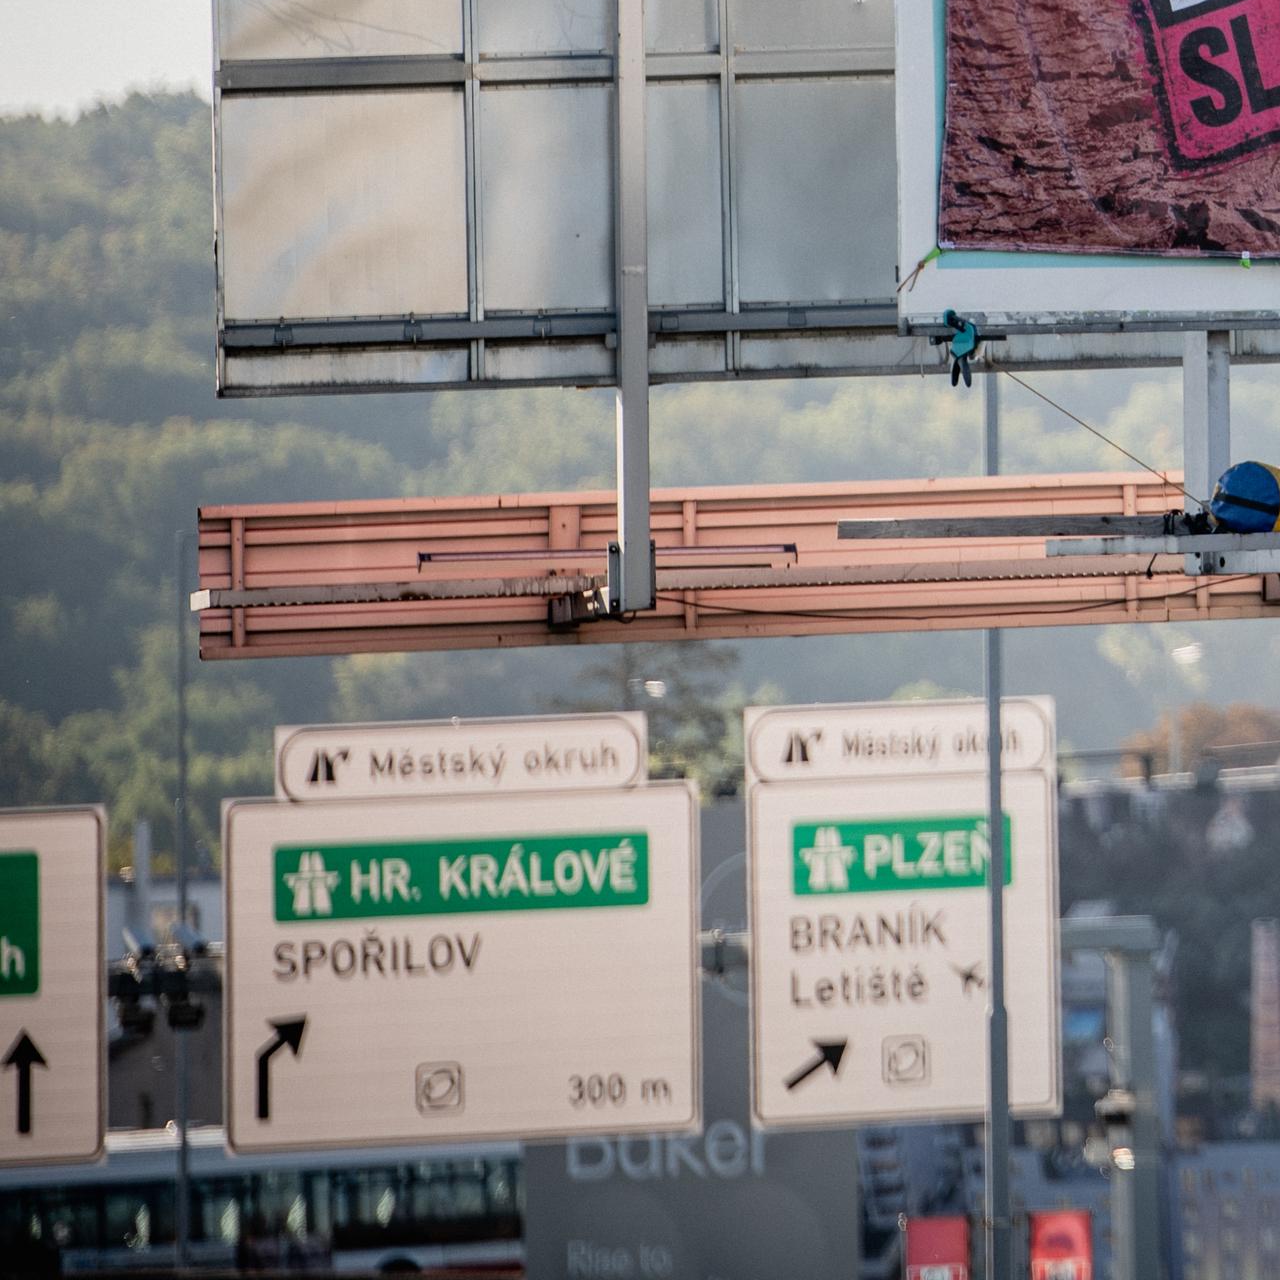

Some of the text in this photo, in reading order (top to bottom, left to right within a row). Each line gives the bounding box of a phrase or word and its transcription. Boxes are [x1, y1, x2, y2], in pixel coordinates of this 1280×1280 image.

[369, 740, 618, 783] Městský okruh
[350, 838, 638, 904] HR. KRÁLOVÉ
[790, 901, 946, 953] BRANÍK
[273, 928, 481, 982] SPOŘILOV
[790, 963, 926, 1008] Letiště
[568, 1073, 672, 1108] 300 m
